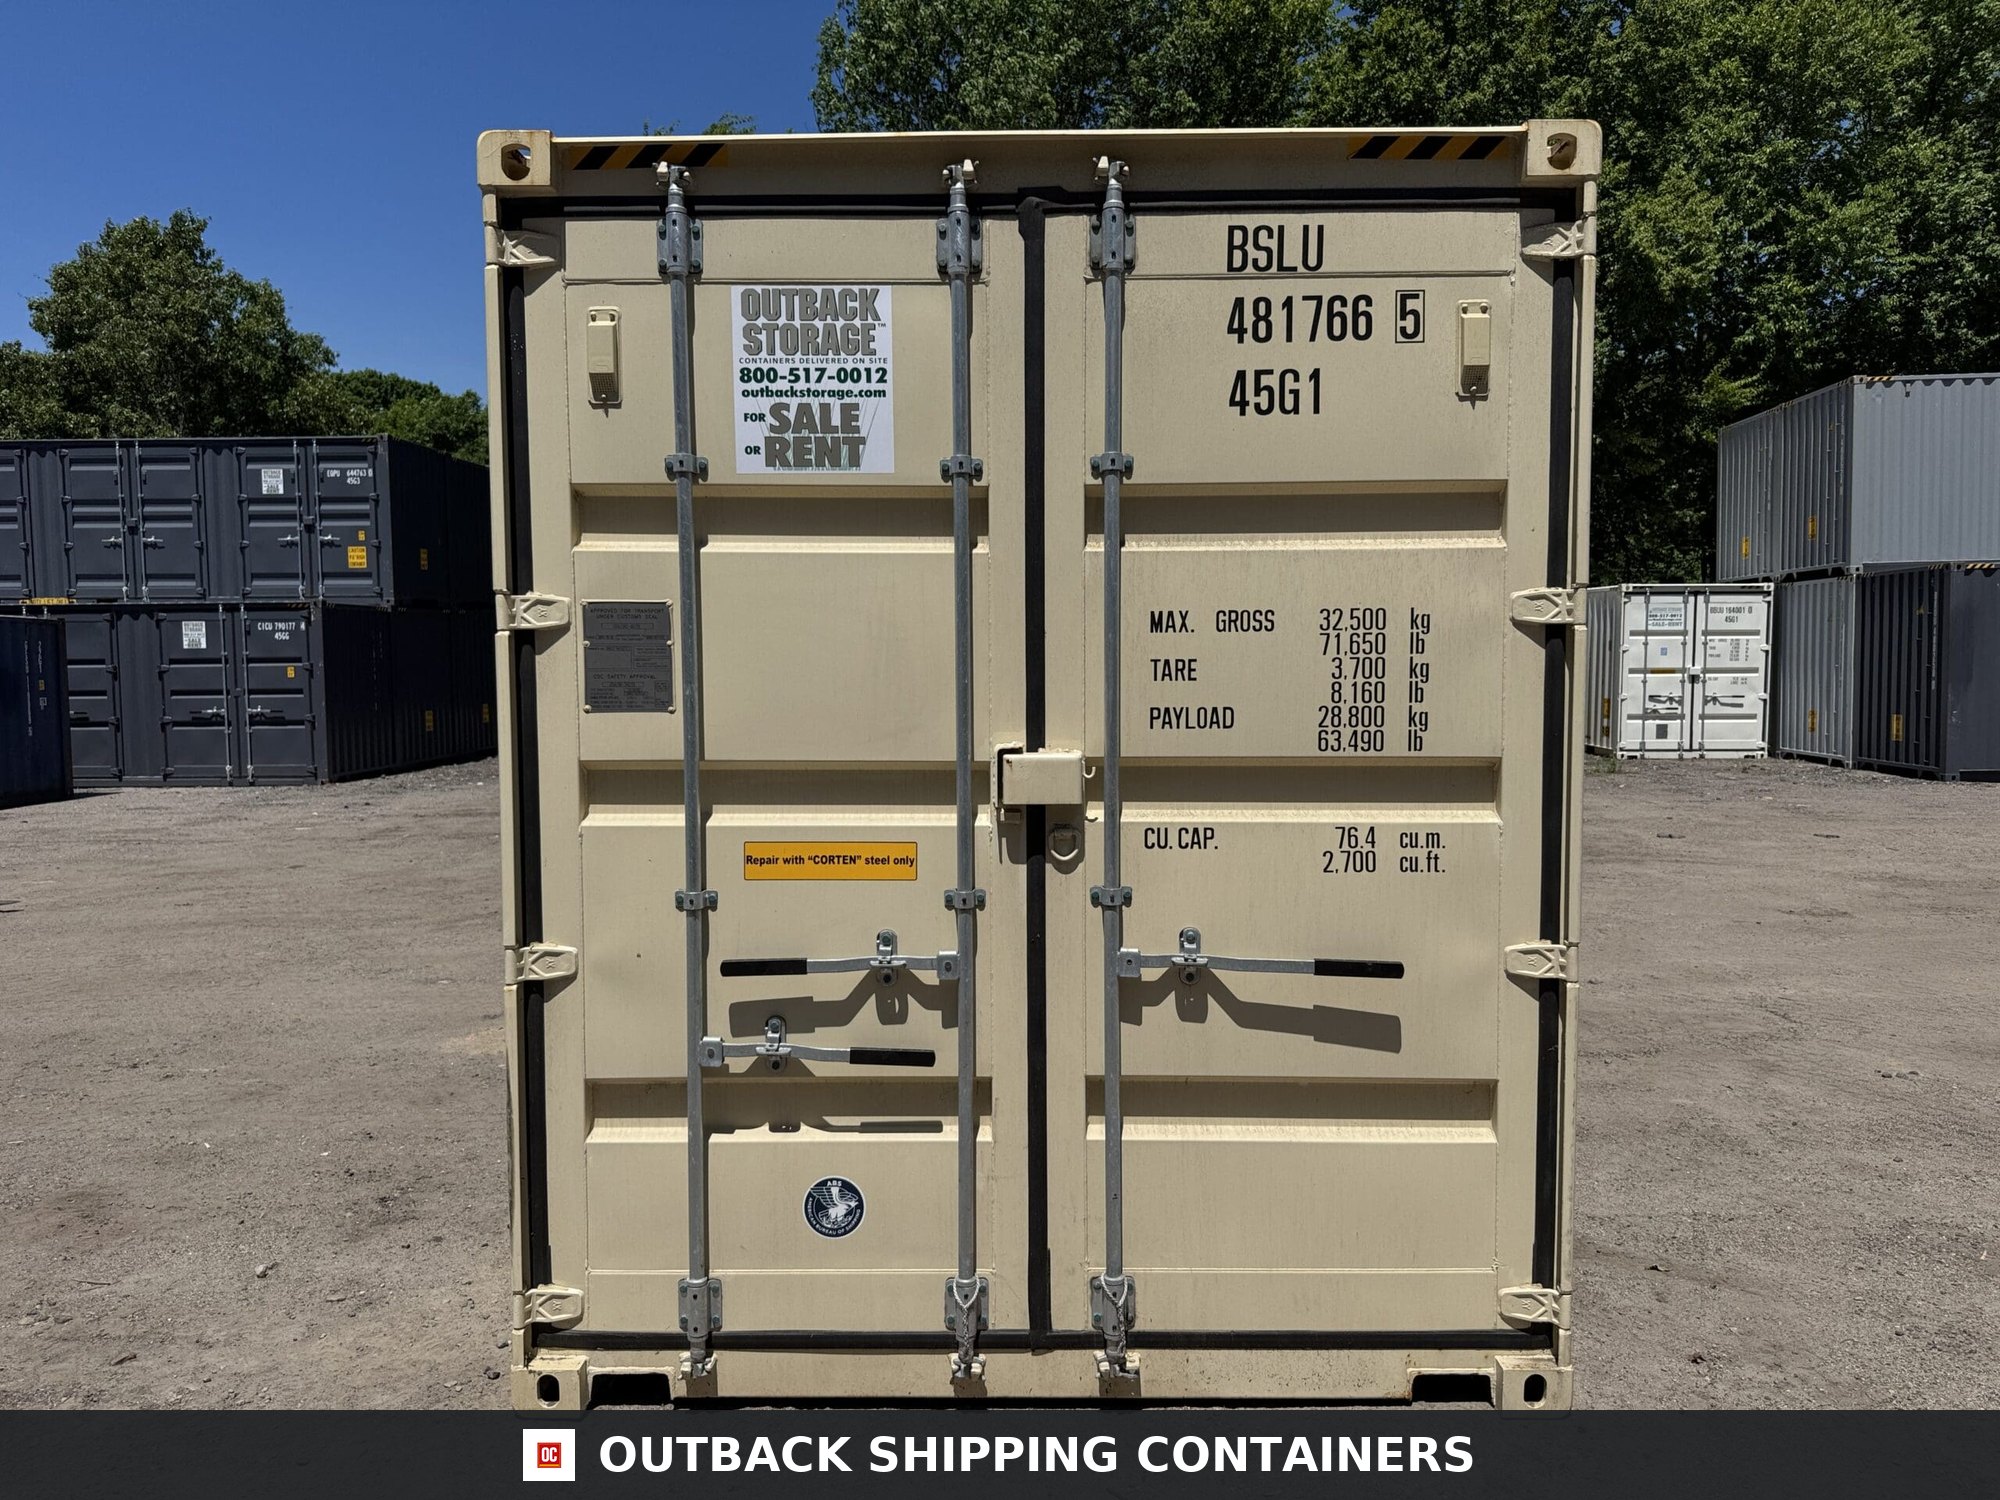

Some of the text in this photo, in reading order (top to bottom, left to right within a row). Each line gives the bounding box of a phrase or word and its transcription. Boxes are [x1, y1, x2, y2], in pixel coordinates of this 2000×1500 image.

[1226, 224, 1324, 272] BSLU
[740, 288, 881, 321] OUTBACK
[1227, 293, 1421, 344] 481766 5
[740, 367, 887, 384] 800-517-0012
[742, 386, 886, 400] outbackstorage.com
[1229, 368, 1320, 416] 45G1
[744, 402, 860, 434] FOR SALE
[744, 436, 866, 468] OR RENT
[1150, 607, 1430, 634] MAX. GROSS 32,500 kg
[1319, 632, 1425, 656] 71,650 lb
[1150, 657, 1429, 683] TARE 3,700 kg
[1331, 681, 1424, 704] 8,160 lb
[1150, 705, 1428, 732] PAYLOAD 28,800 kg
[1318, 729, 1423, 752] 63,490 lb
[1335, 826, 1376, 849] 76.4
[1400, 832, 1446, 849] cu.m.
[746, 855, 780, 867] Repair
[783, 855, 805, 865] with
[865, 855, 890, 865] steel
[893, 855, 915, 867] only
[1322, 850, 1446, 874] 2,700 cu.ft.
[816, 1224, 836, 1234] BUREAU
